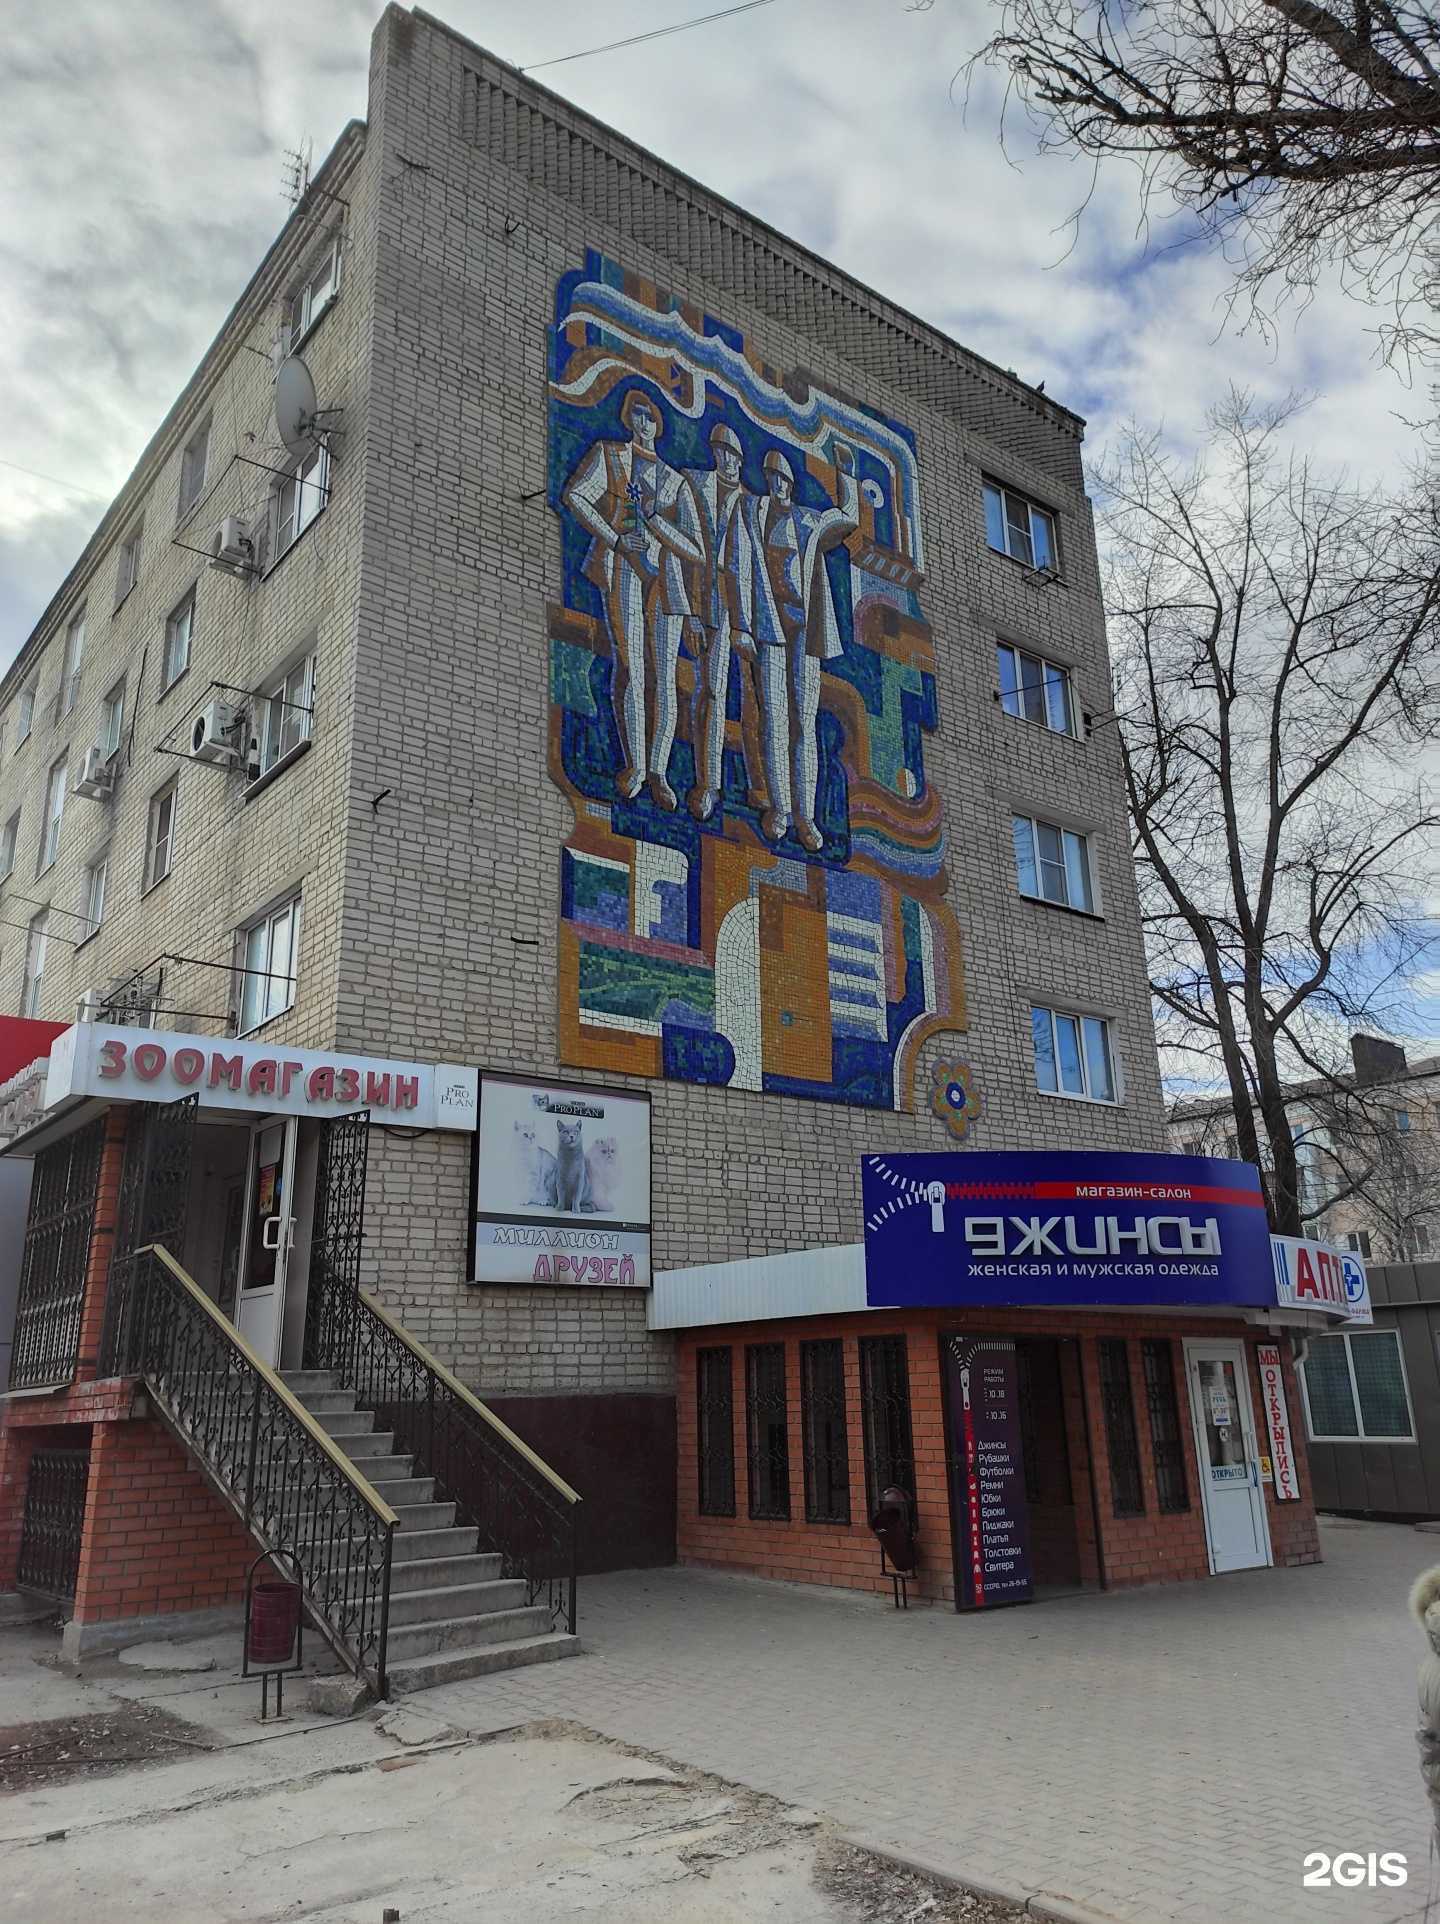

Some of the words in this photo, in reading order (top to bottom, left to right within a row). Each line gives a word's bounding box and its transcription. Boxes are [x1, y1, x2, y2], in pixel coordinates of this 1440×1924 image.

[98, 1039, 419, 1111] ЗООМАГАЗИН
[446, 1087, 470, 1098] PRO
[441, 1095, 474, 1108] PLAN
[1076, 1186, 1192, 1199] магазин-салон
[493, 1226, 620, 1250] МИЛЛИОН
[533, 1253, 636, 1285] ДРУЗЕЙ
[968, 1263, 1051, 1276] женская
[1057, 1263, 1068, 1275] и
[1073, 1263, 1154, 1279] мужская
[1158, 1262, 1219, 1276] одежда
[1259, 1350, 1280, 1365] МЫ
[1265, 1369, 1293, 1499] ОТКРЫЛИСЬ
[978, 1440, 1007, 1450] Джинсы
[979, 1453, 1010, 1465] Рубашки
[980, 1466, 1014, 1478] Футболки
[980, 1480, 1004, 1489] Ремни
[981, 1493, 1001, 1503] Юбки
[981, 1507, 1005, 1518] Брюки
[982, 1520, 1015, 1531] Пиджаки
[983, 1534, 1009, 1544] Платья
[983, 1546, 1022, 1558] Толстовки
[984, 1561, 1015, 1572] Свитера
